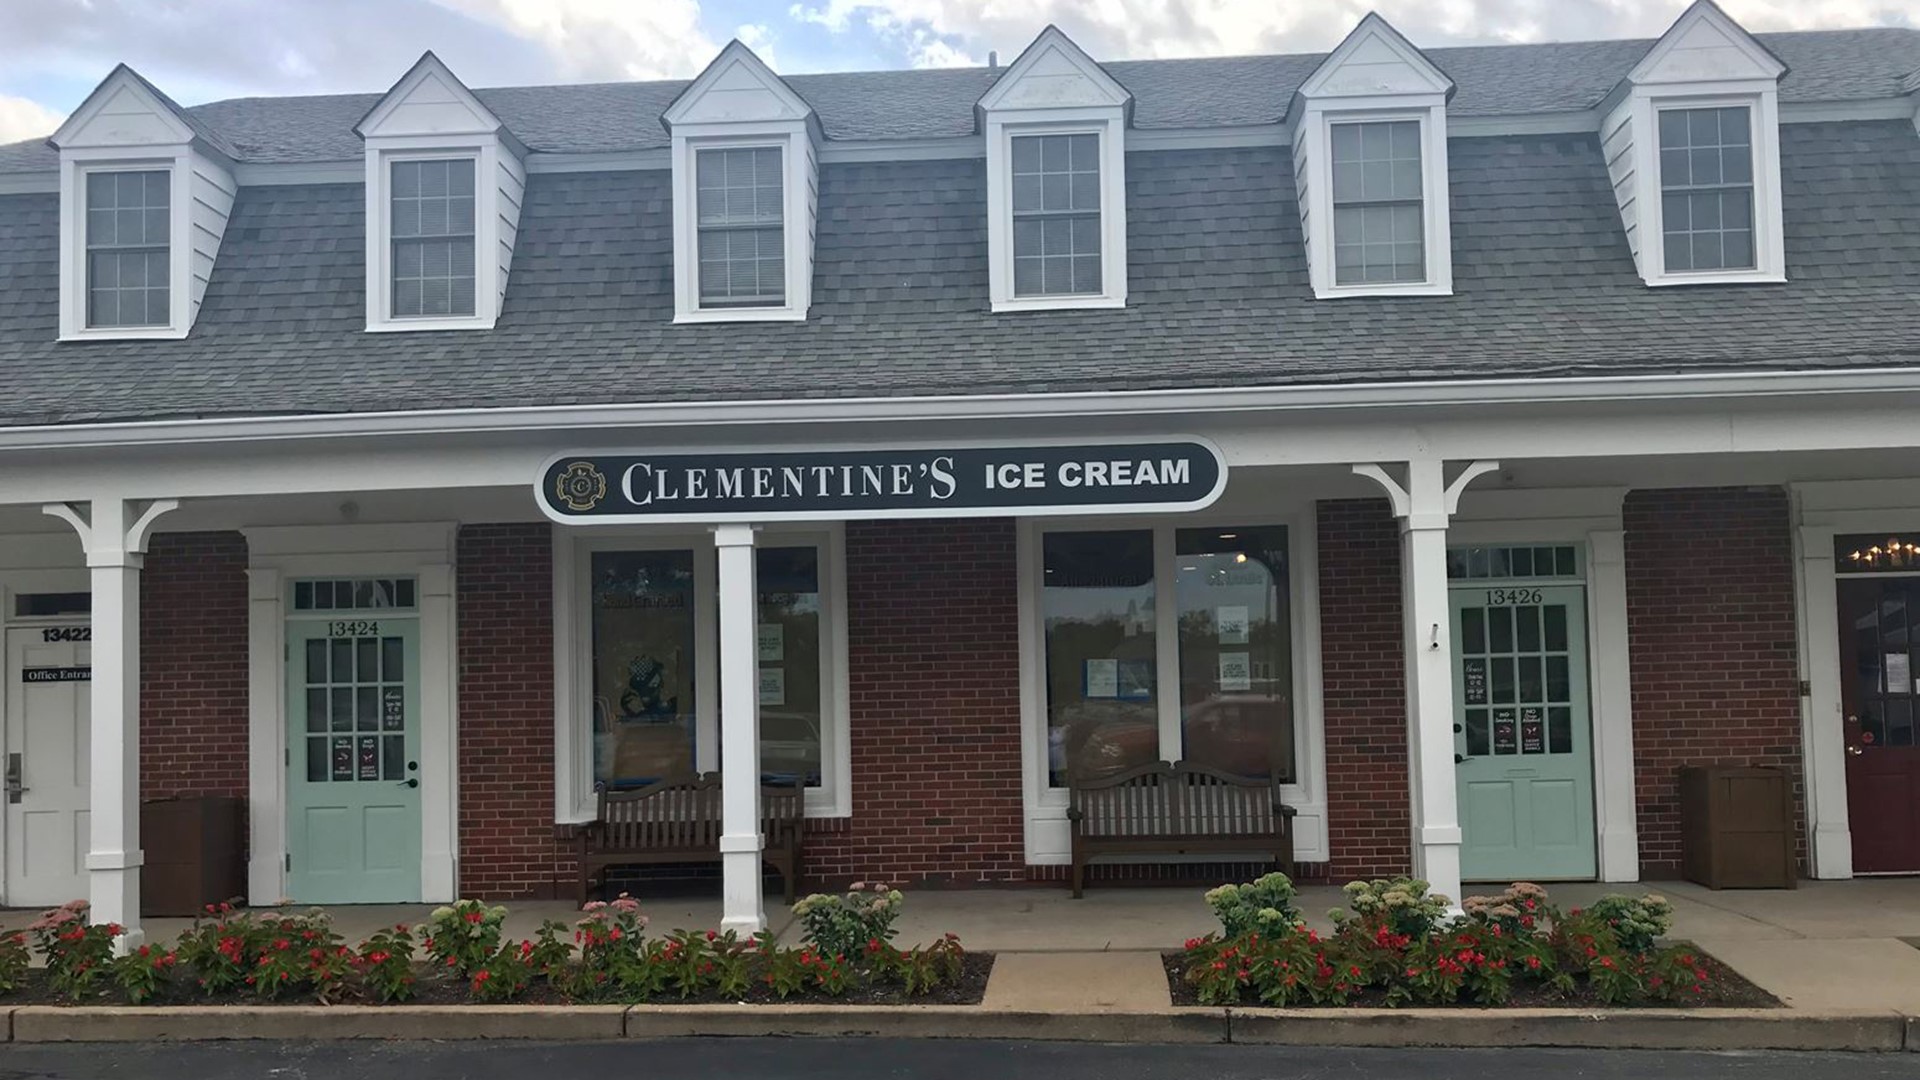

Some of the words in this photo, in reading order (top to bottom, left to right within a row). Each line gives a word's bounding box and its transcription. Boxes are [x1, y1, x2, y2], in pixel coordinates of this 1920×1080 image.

[621, 456, 957, 506] CLEMENTINE'S
[985, 462, 1045, 489] ICE
[1058, 458, 1191, 488] CREAM
[1486, 589, 1543, 606] 13426
[42, 628, 92, 642] 13422
[328, 621, 379, 637] 13424
[29, 671, 58, 681] Office
